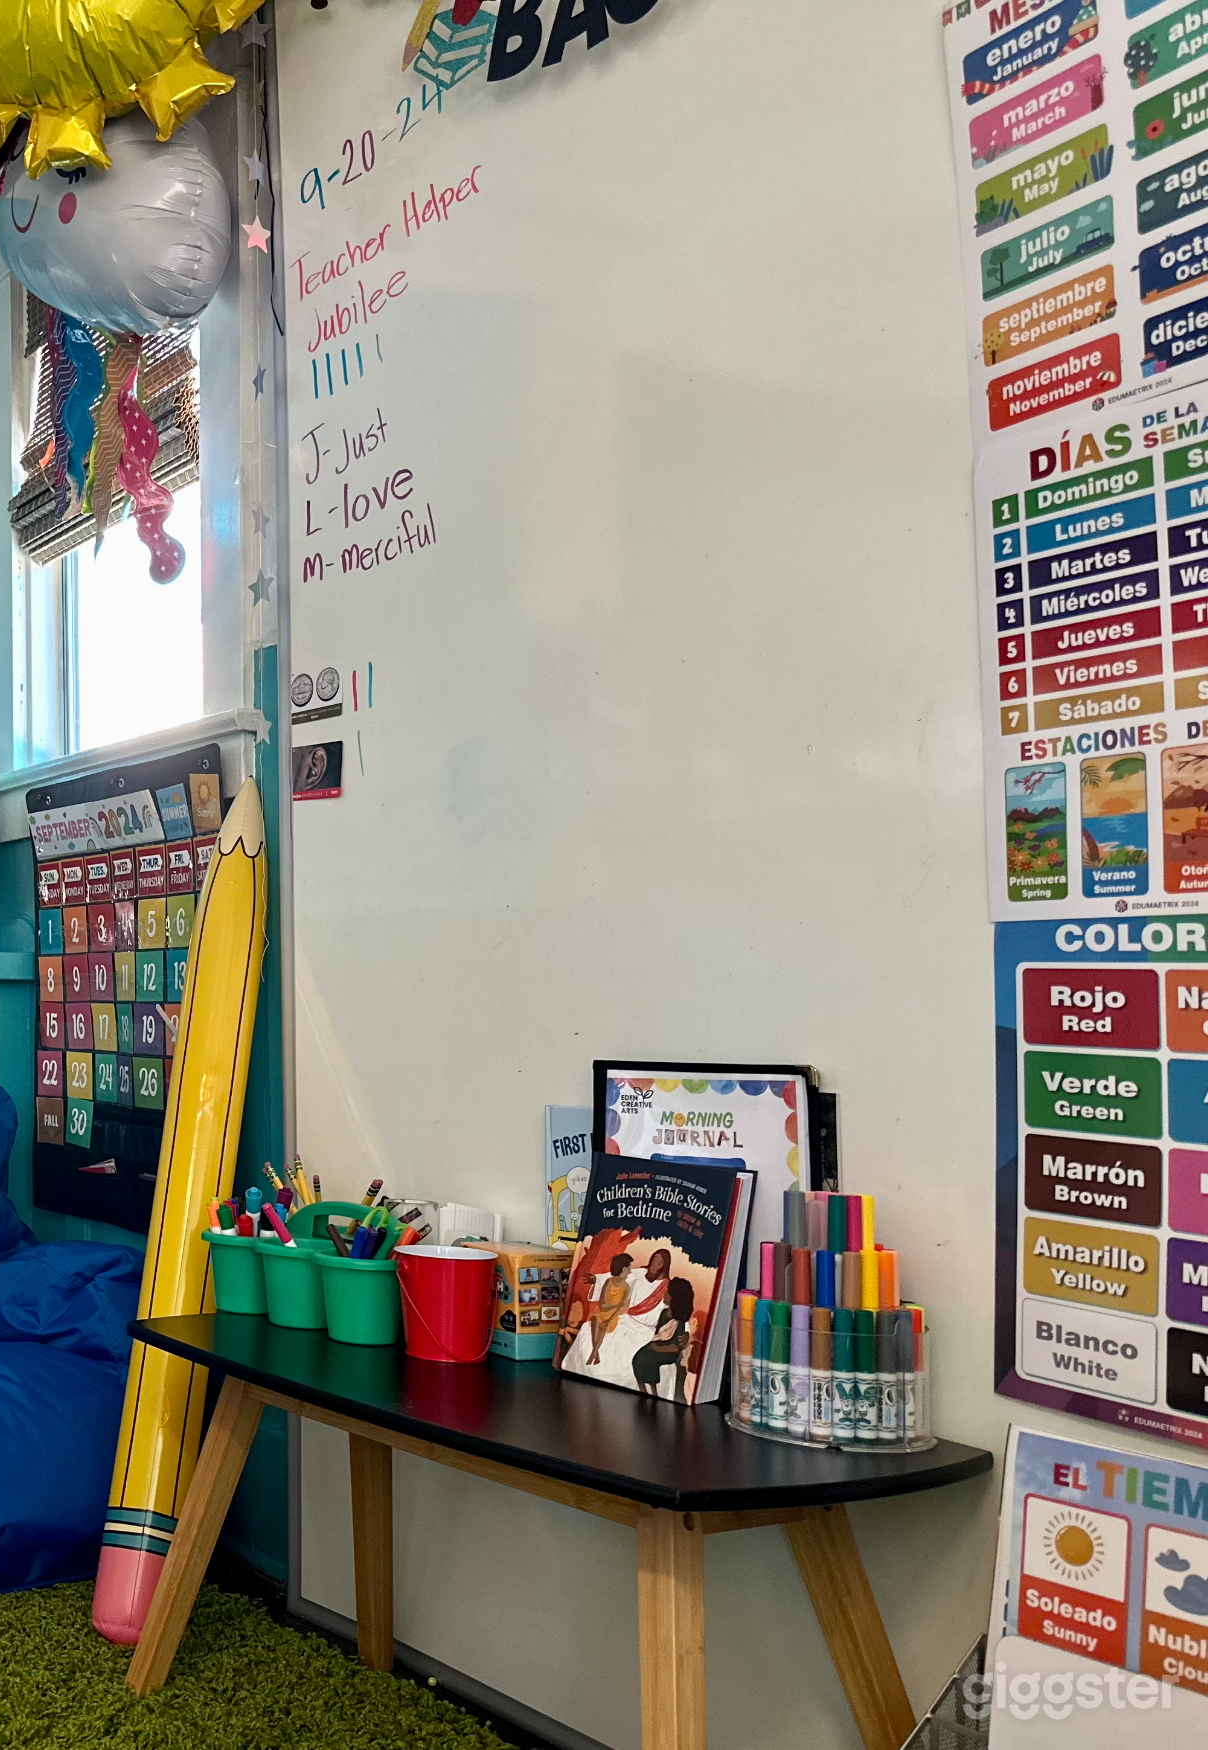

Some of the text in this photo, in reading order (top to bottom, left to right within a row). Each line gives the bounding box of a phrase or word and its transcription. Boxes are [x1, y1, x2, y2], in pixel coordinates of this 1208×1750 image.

[986, 14, 1062, 66] enero
[992, 38, 1059, 82] January
[1002, 80, 1075, 128] marzo
[1011, 105, 1066, 142] March
[300, 74, 447, 210] 9-20-24
[1011, 150, 1074, 190] mayo
[1024, 177, 1059, 202] May
[290, 165, 482, 301] Teacher Helper
[1020, 225, 1070, 263] julio
[1027, 249, 1063, 273] July
[307, 270, 409, 352] Jubilee
[999, 276, 1106, 332] septiembre
[1009, 300, 1102, 347] September
[1002, 350, 1102, 400] noviembre
[1009, 377, 1092, 417] November
[1108, 385, 1153, 405] EDUMAETRIX
[1142, 401, 1198, 428] DE LA
[1029, 423, 1132, 482] DÍAS
[1000, 470, 1139, 520] 1 Domingo
[1002, 512, 1125, 555] 2 Lunes
[1003, 549, 1131, 589] 3 Martes
[1004, 581, 1147, 623] 4 Miércoles
[1006, 622, 1134, 658] 5 Jueves
[1007, 659, 1138, 693] 6 Viernes
[1008, 695, 1140, 728] 7 Sábado
[1020, 723, 1168, 761] ESTACIONES
[36, 804, 143, 844] SEPTEMBER 2024
[161, 805, 188, 821] SUMMER
[196, 808, 215, 820] Sunny
[139, 876, 165, 888] THURSDAY
[170, 872, 190, 885] FRIDAY
[1009, 875, 1066, 887] Primavera
[1093, 870, 1136, 882] Verano
[1094, 884, 1136, 894] Summer
[1021, 888, 1051, 898] Spring
[1181, 900, 1199, 908] 2024
[71, 917, 79, 943] 2
[97, 914, 106, 941] 3
[146, 910, 156, 937] 5
[176, 907, 185, 936] 6
[47, 967, 54, 992] 8
[73, 966, 81, 992] 9
[95, 964, 107, 991] 10
[121, 964, 129, 991] 11
[143, 963, 156, 991] 12
[1050, 985, 1126, 1013] Rojo
[46, 1012, 58, 1038] 15
[72, 1013, 85, 1040] 16
[98, 1014, 109, 1041] 17
[121, 1015, 129, 1042] 18
[142, 1015, 156, 1043] 19
[1062, 1015, 1112, 1033] Red
[42, 1059, 158, 1096] 22 23 24 25 26
[1041, 1071, 1139, 1098] Verde
[44, 1108, 87, 1135] FALL 30
[660, 1110, 734, 1128] MORNING
[1054, 1100, 1124, 1121] Green
[552, 1133, 587, 1159] FIRST
[1042, 1154, 1145, 1188] Marrón
[596, 1183, 722, 1226] Children's Bible Stories
[603, 1201, 672, 1222] for Bedtime
[1054, 1185, 1128, 1209] Brown
[1032, 1235, 1146, 1273] Amarillo
[1050, 1268, 1126, 1297] Yellow
[1035, 1320, 1139, 1360] Blanco
[1052, 1352, 1118, 1382] White
[1133, 1416, 1183, 1434] EDUMAETRIX
[1053, 1462, 1088, 1492] EL
[1025, 1588, 1117, 1632] Soleado
[1042, 1619, 1098, 1652] Sunny
